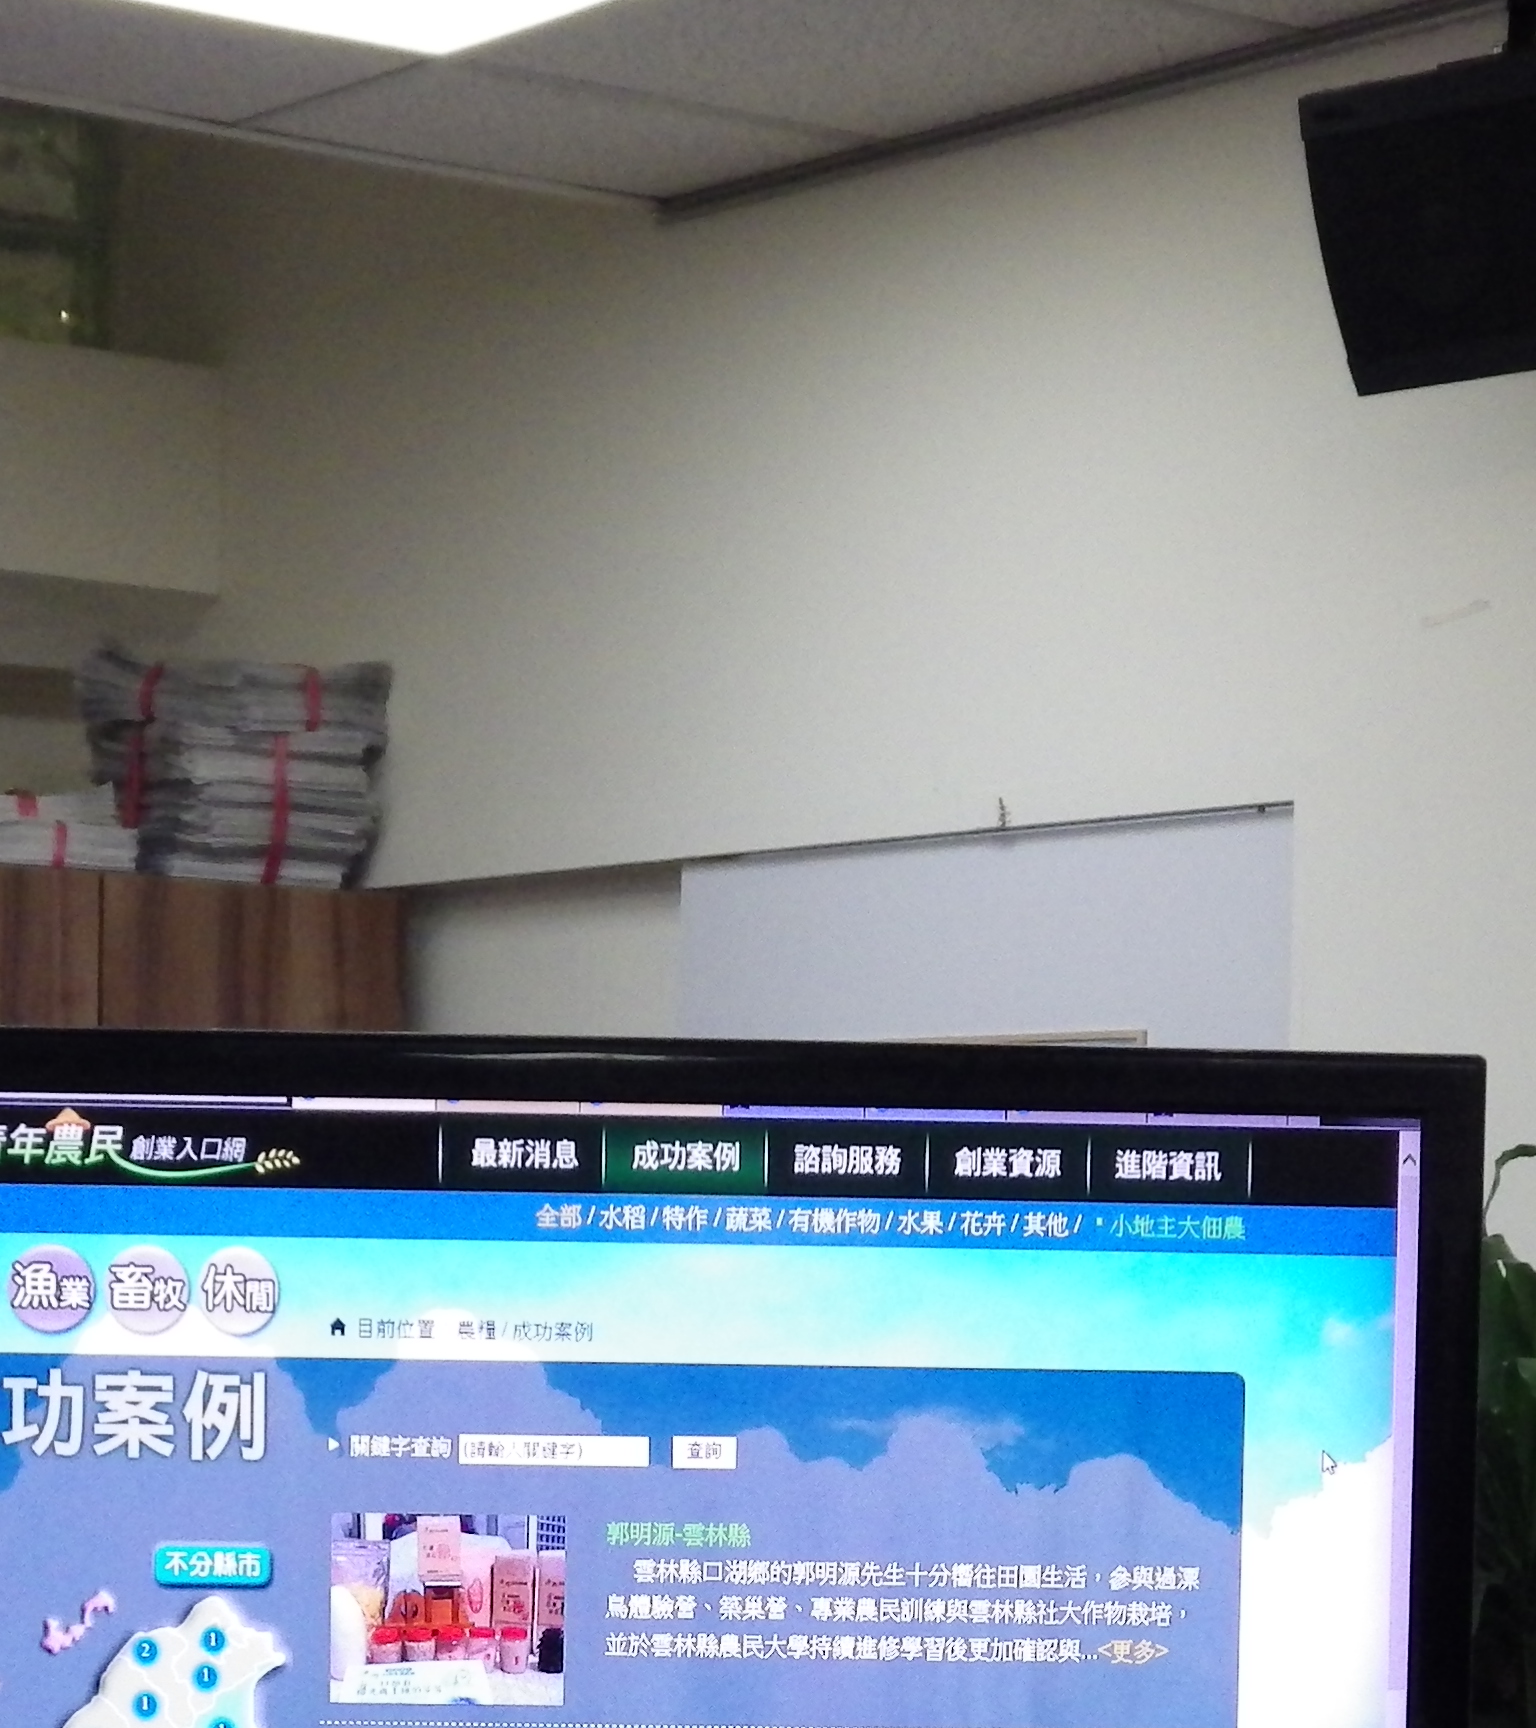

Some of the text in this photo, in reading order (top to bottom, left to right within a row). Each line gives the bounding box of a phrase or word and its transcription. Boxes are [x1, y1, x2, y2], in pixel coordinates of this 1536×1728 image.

[130, 1134, 246, 1163] 創業入口網
[471, 1137, 578, 1172] 最新消息
[631, 1141, 739, 1175] 成功案例
[793, 1142, 901, 1178] 諮詢服務
[954, 1145, 1061, 1181] 創業資源
[1115, 1148, 1222, 1183] 進階資訊
[535, 1204, 582, 1232] 全部
[898, 1209, 943, 1239] 水果
[960, 1210, 1006, 1240] 花卉
[1023, 1211, 1070, 1241] 其他
[1110, 1215, 1246, 1240] 小地主大佃農
[10, 1260, 93, 1312] 漁業
[107, 1262, 187, 1313] 畜牧
[349, 1433, 452, 1459] 關鍵字查詢
[686, 1441, 722, 1461] 查詢
[607, 1521, 752, 1549] 郭明源-雲林縣
[165, 1552, 262, 1578] 不分縣市
